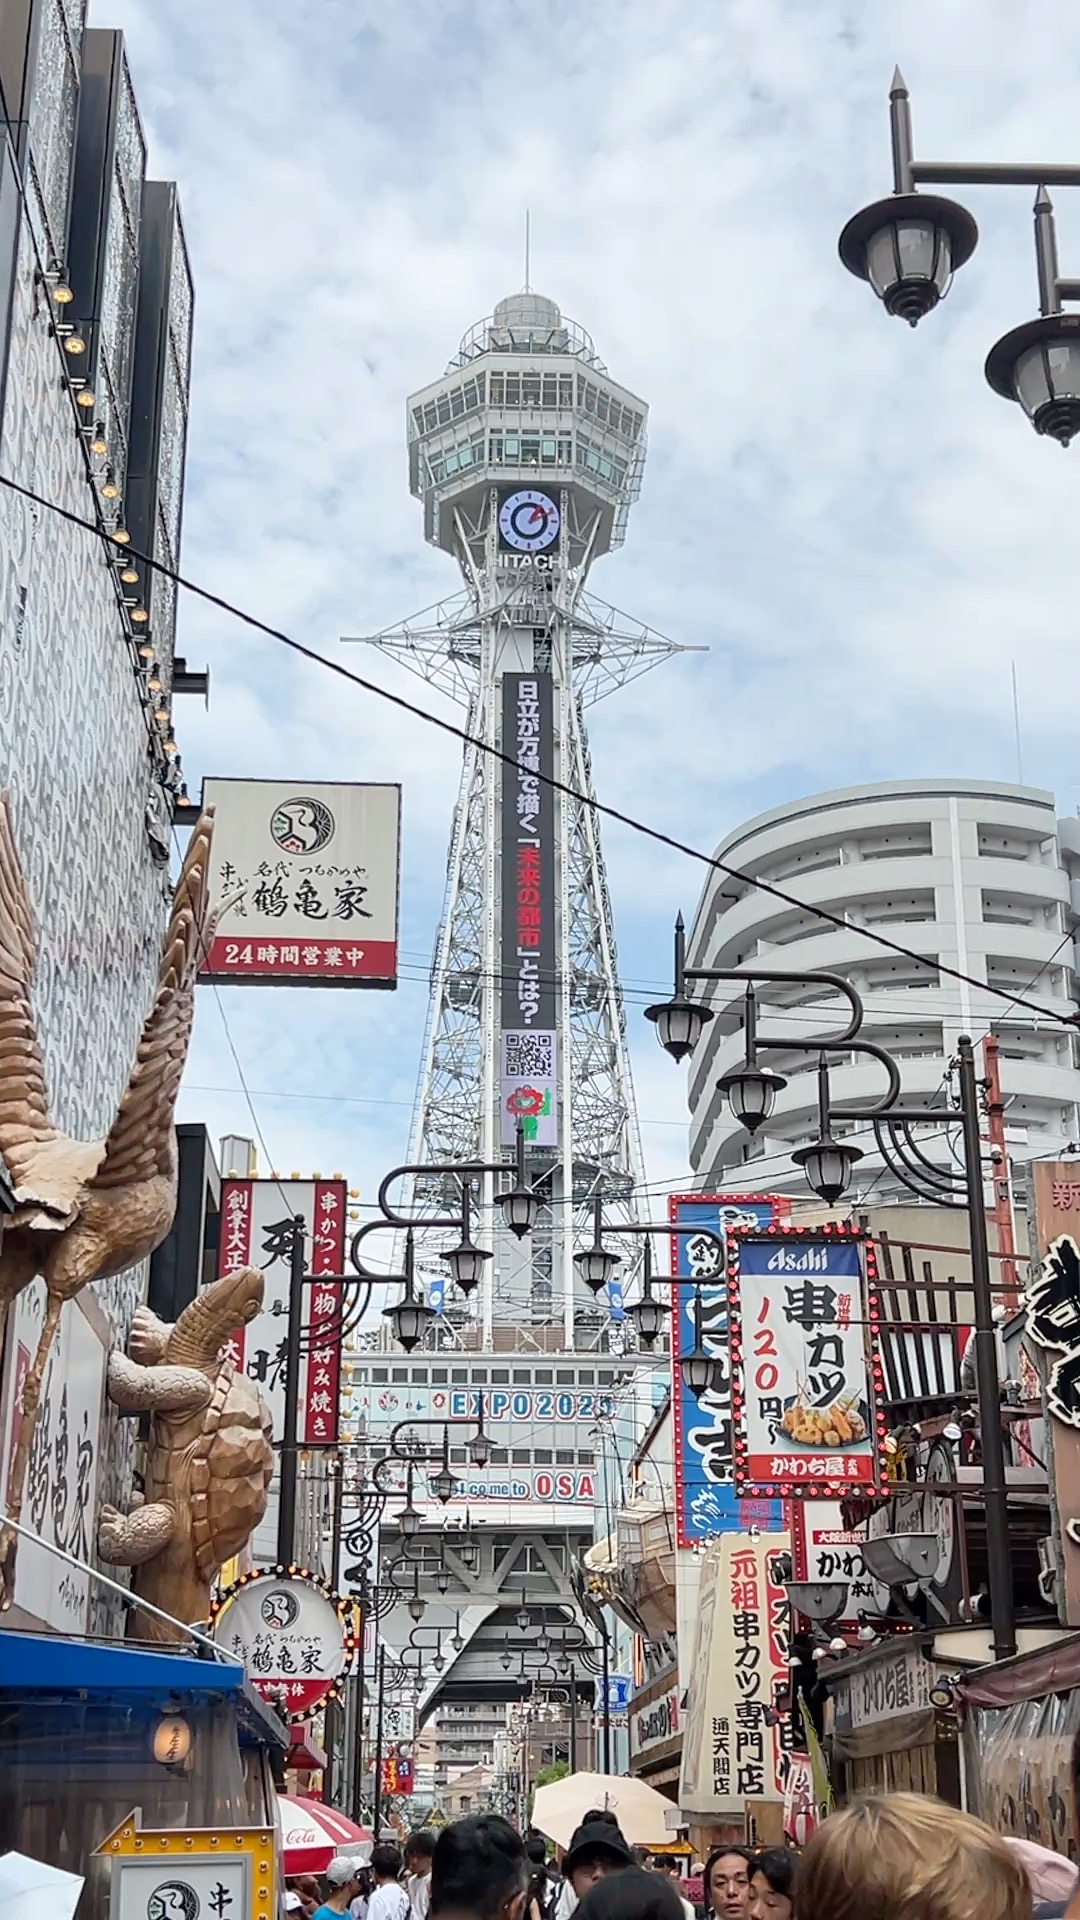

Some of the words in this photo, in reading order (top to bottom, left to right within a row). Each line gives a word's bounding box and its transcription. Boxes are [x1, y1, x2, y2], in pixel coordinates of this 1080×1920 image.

[252, 877, 373, 920] 鶴亀家
[225, 943, 365, 967] 24時間営業中
[768, 1247, 828, 1272] Asahi
[782, 1279, 847, 1408] 串カツ
[451, 1391, 530, 1418] EXPO
[769, 1456, 846, 1477] かわち屋
[513, 1481, 527, 1497] to
[536, 1474, 595, 1497] OSA
[252, 1644, 325, 1674] 鶴亀家
[729, 1549, 765, 1796] 元祖串カツ専門店
